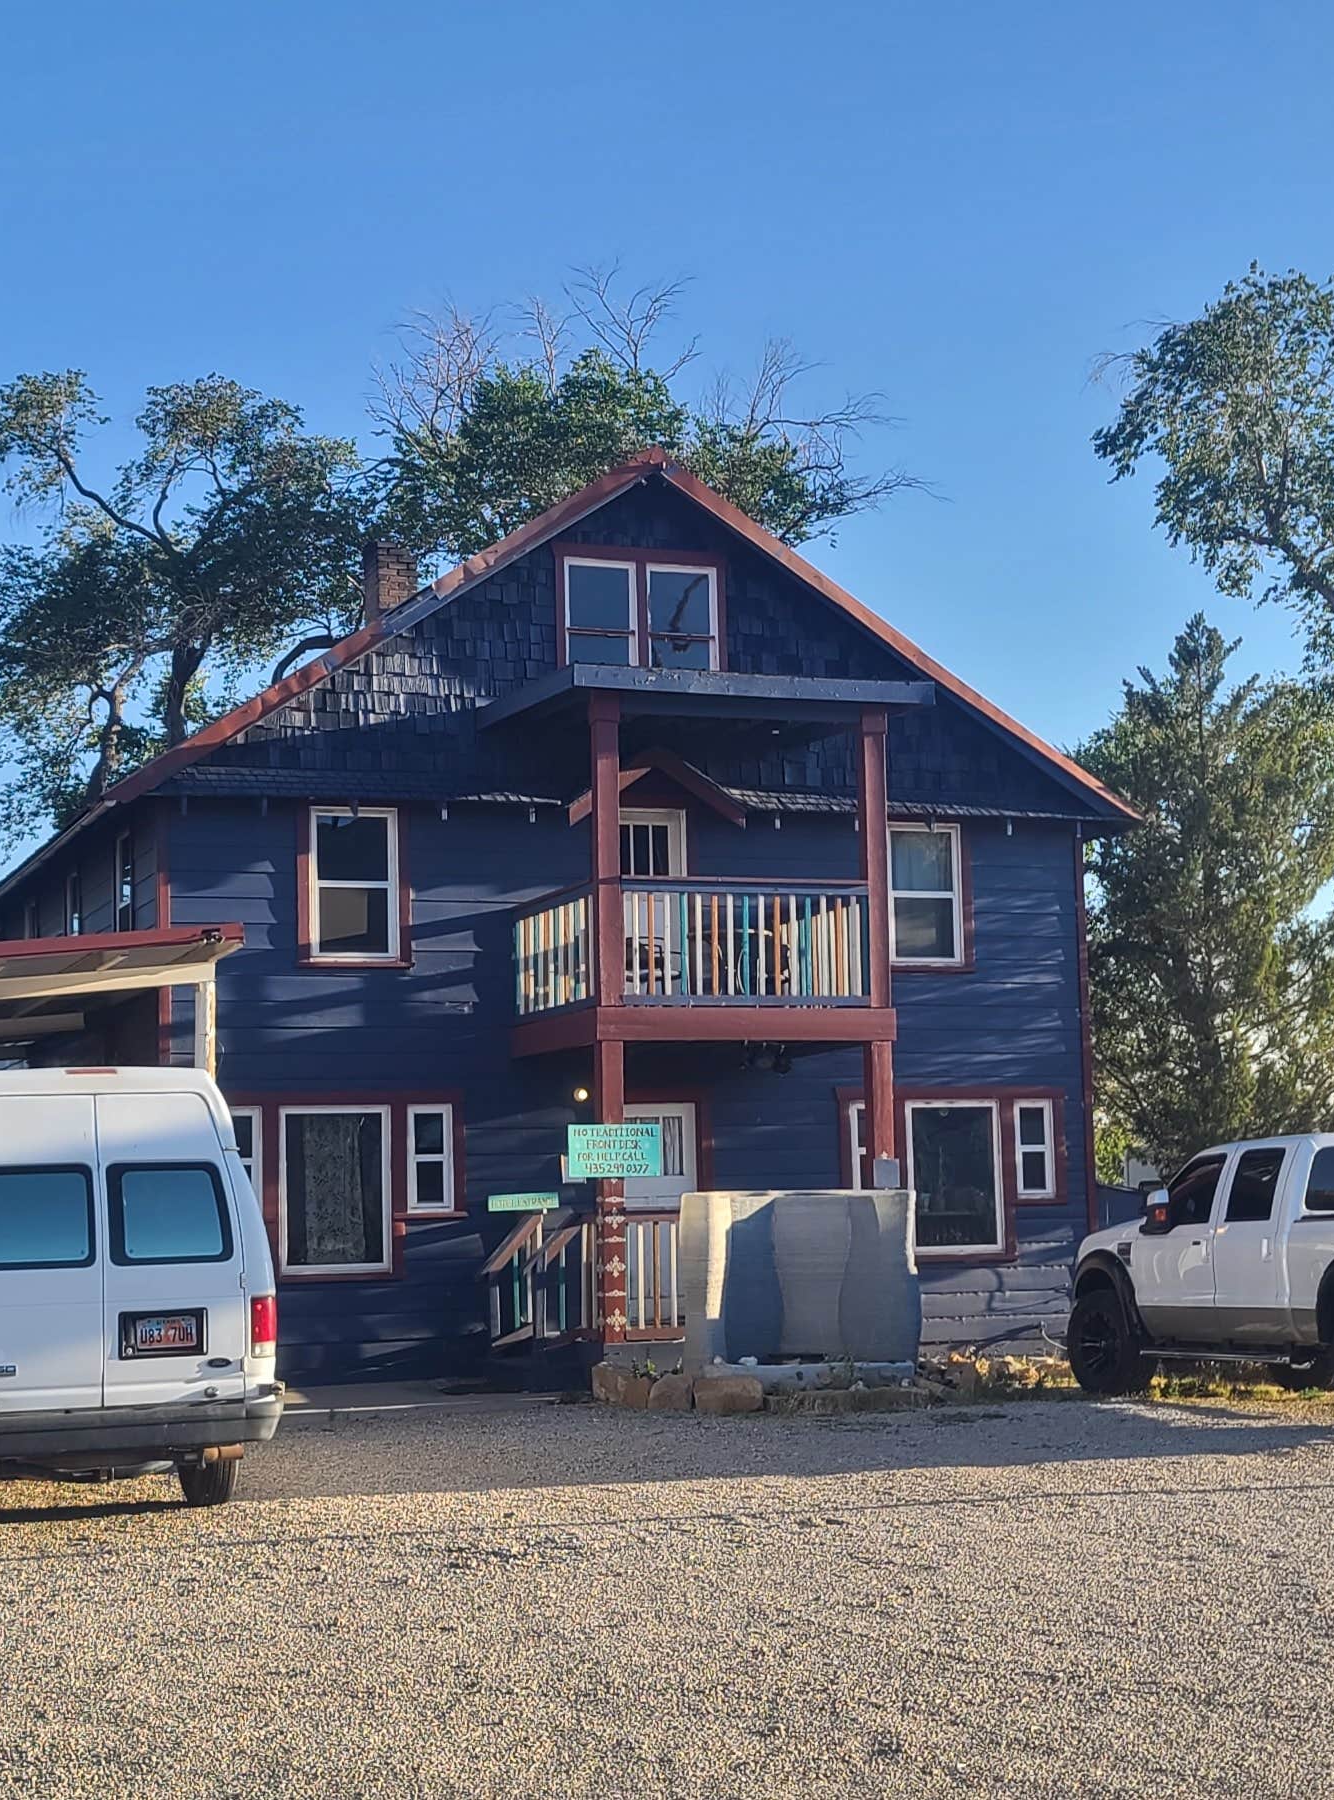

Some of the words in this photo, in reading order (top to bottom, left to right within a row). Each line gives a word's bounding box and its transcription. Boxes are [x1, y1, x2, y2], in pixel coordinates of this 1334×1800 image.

[573, 1127, 588, 1137] NO
[586, 1139, 618, 1150] FRONT
[620, 1139, 642, 1150] DESK
[622, 1151, 647, 1161] CALL
